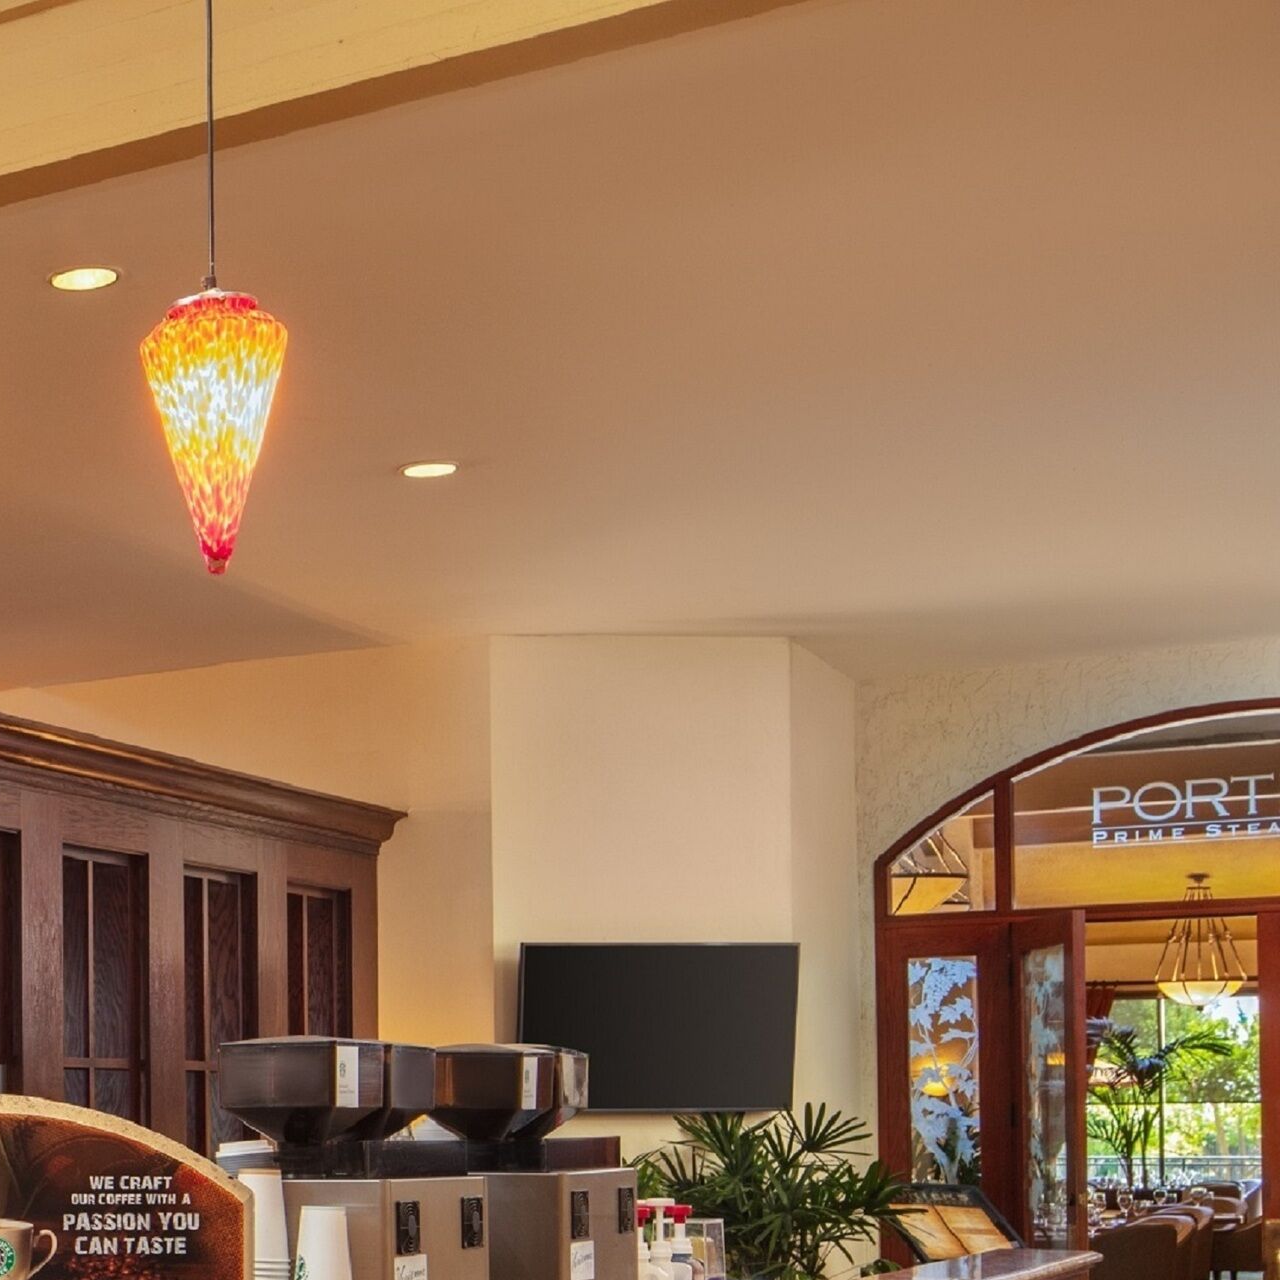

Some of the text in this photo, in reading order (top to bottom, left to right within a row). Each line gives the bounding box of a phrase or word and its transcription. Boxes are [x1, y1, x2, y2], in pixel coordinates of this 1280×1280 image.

[1092, 828, 1185, 844] PRIME
[89, 1175, 172, 1190] WE CRAFT
[71, 1193, 191, 1205] OUR COFFEE WITH A
[62, 1212, 200, 1231] PASSION YOU
[74, 1236, 187, 1255] CAN TASTE
